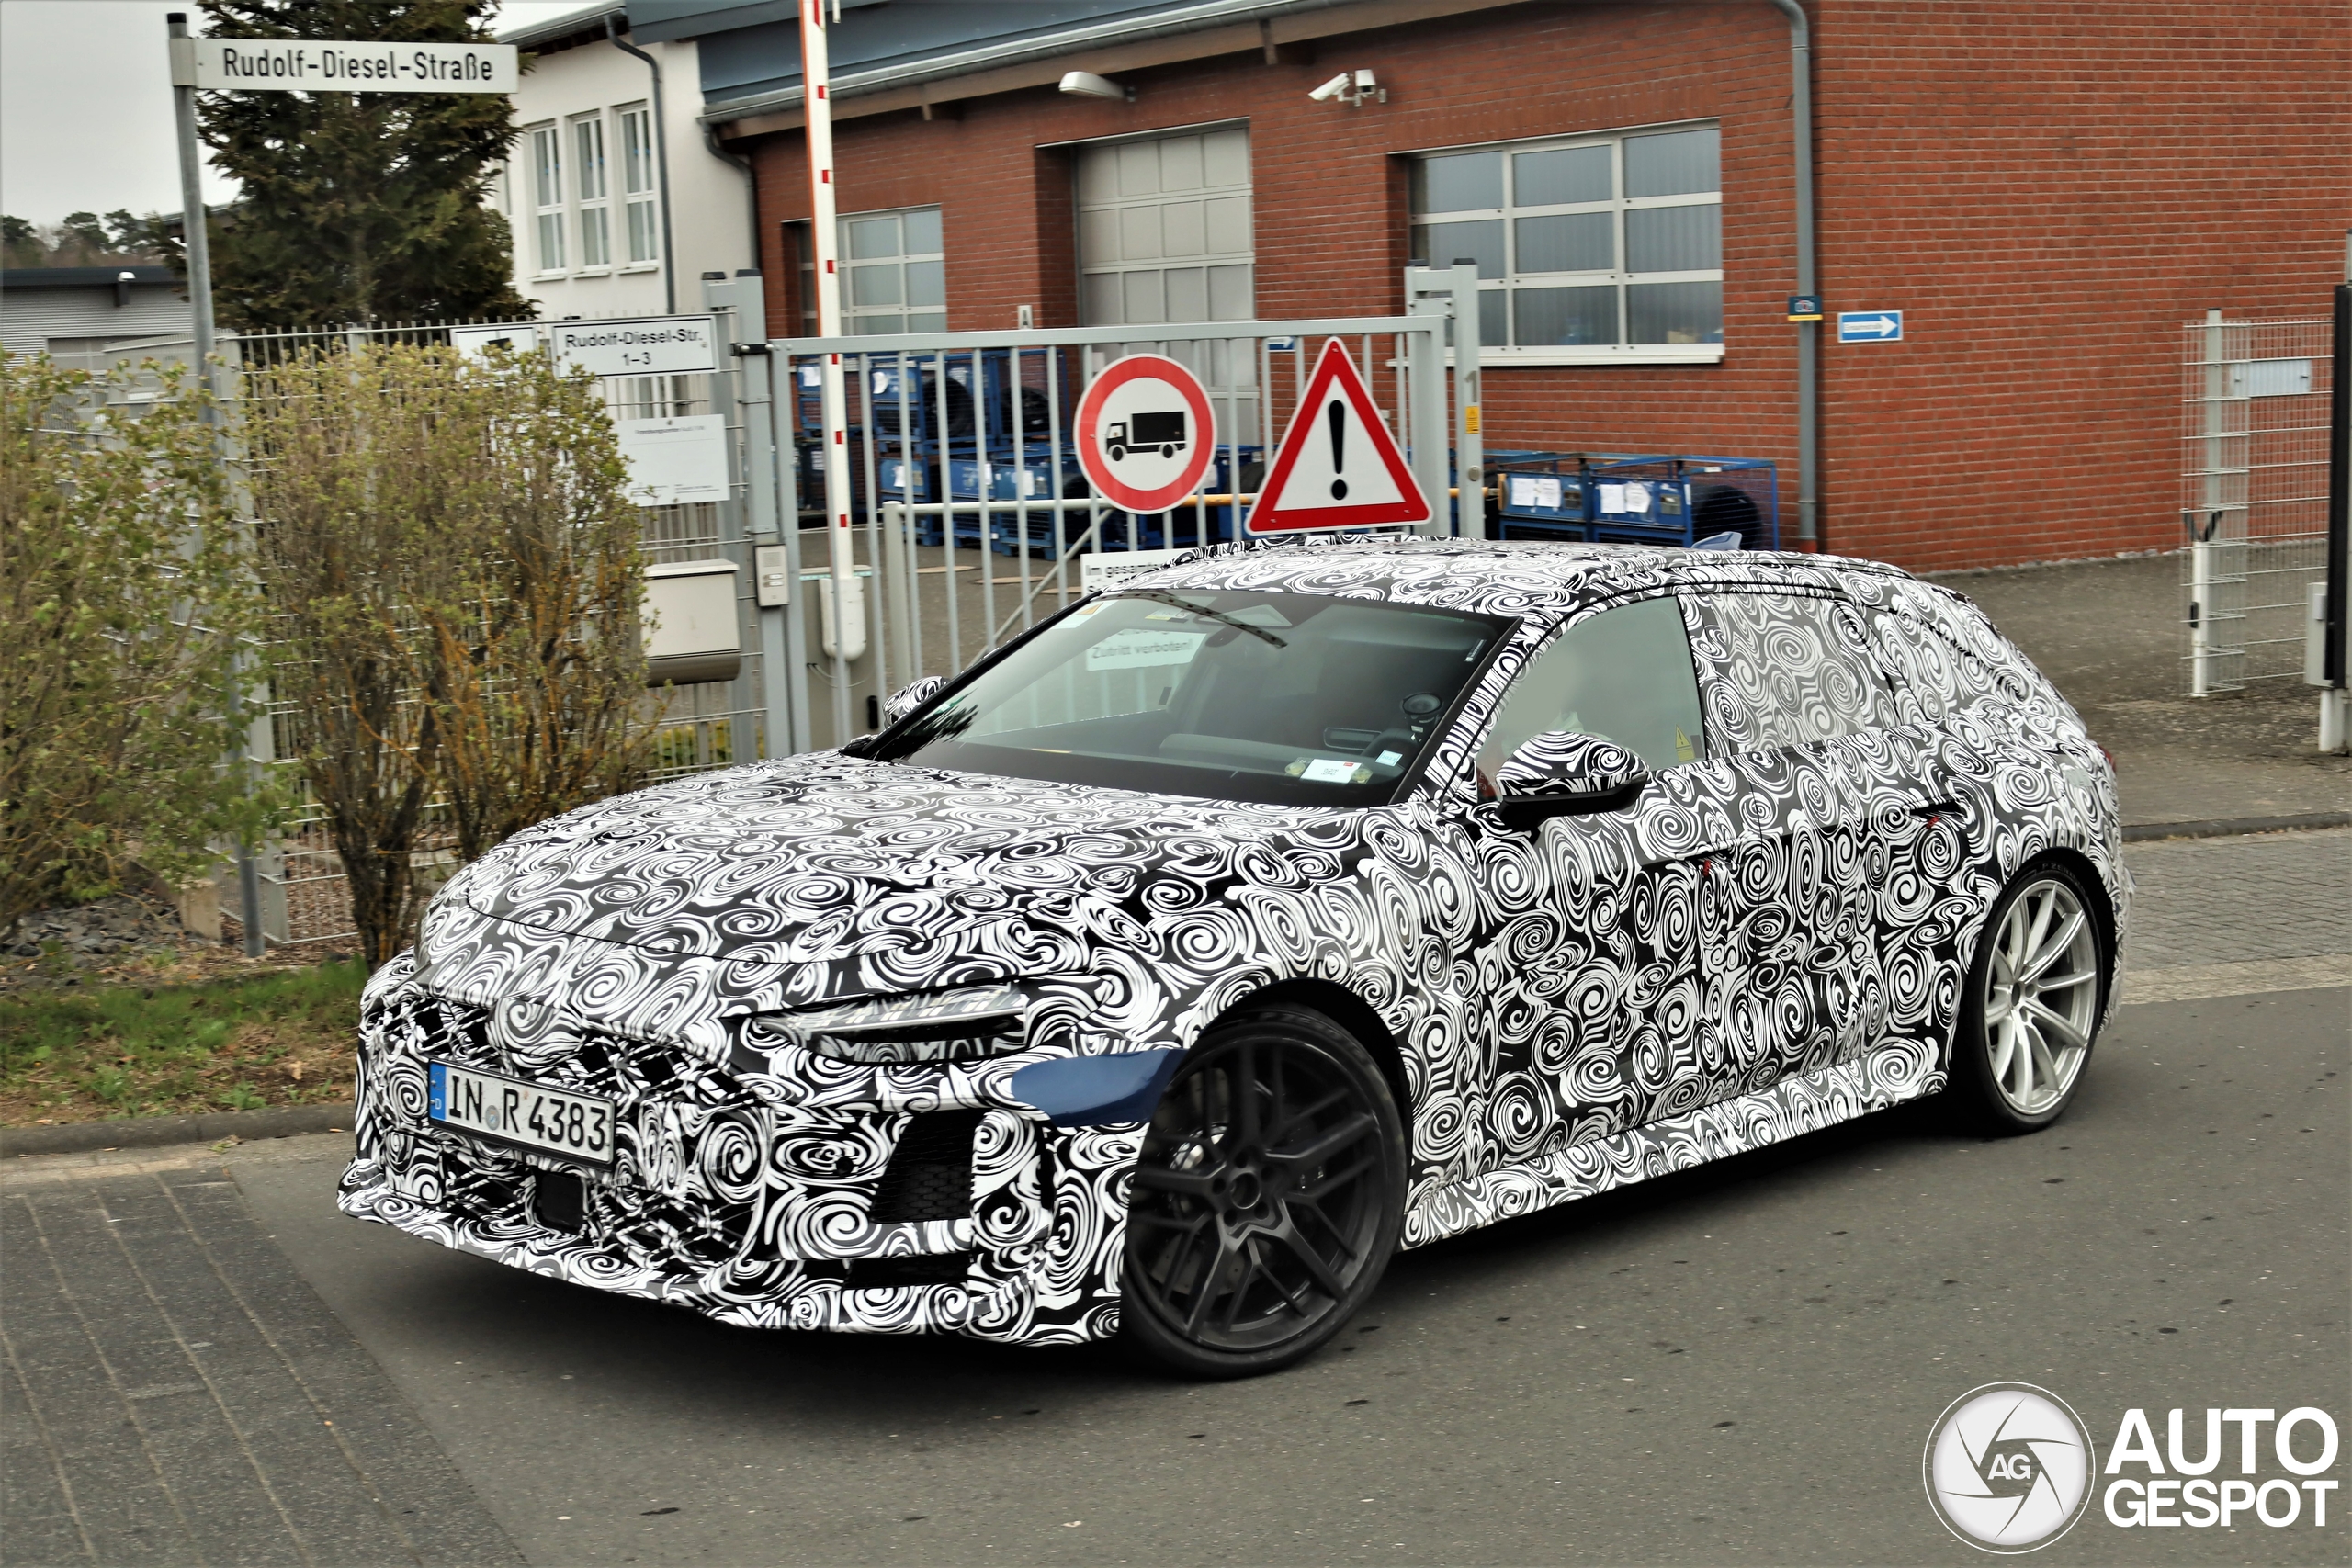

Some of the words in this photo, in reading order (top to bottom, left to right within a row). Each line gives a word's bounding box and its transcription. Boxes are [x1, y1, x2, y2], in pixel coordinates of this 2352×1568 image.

[223, 47, 493, 81] Rudolf-Diesel-Straße
[565, 328, 703, 348] Rudolf-Diesel-Str.
[436, 1098, 443, 1110] D
[449, 1075, 482, 1124] IN
[503, 1087, 520, 1134] R
[528, 1094, 606, 1152] 4383
